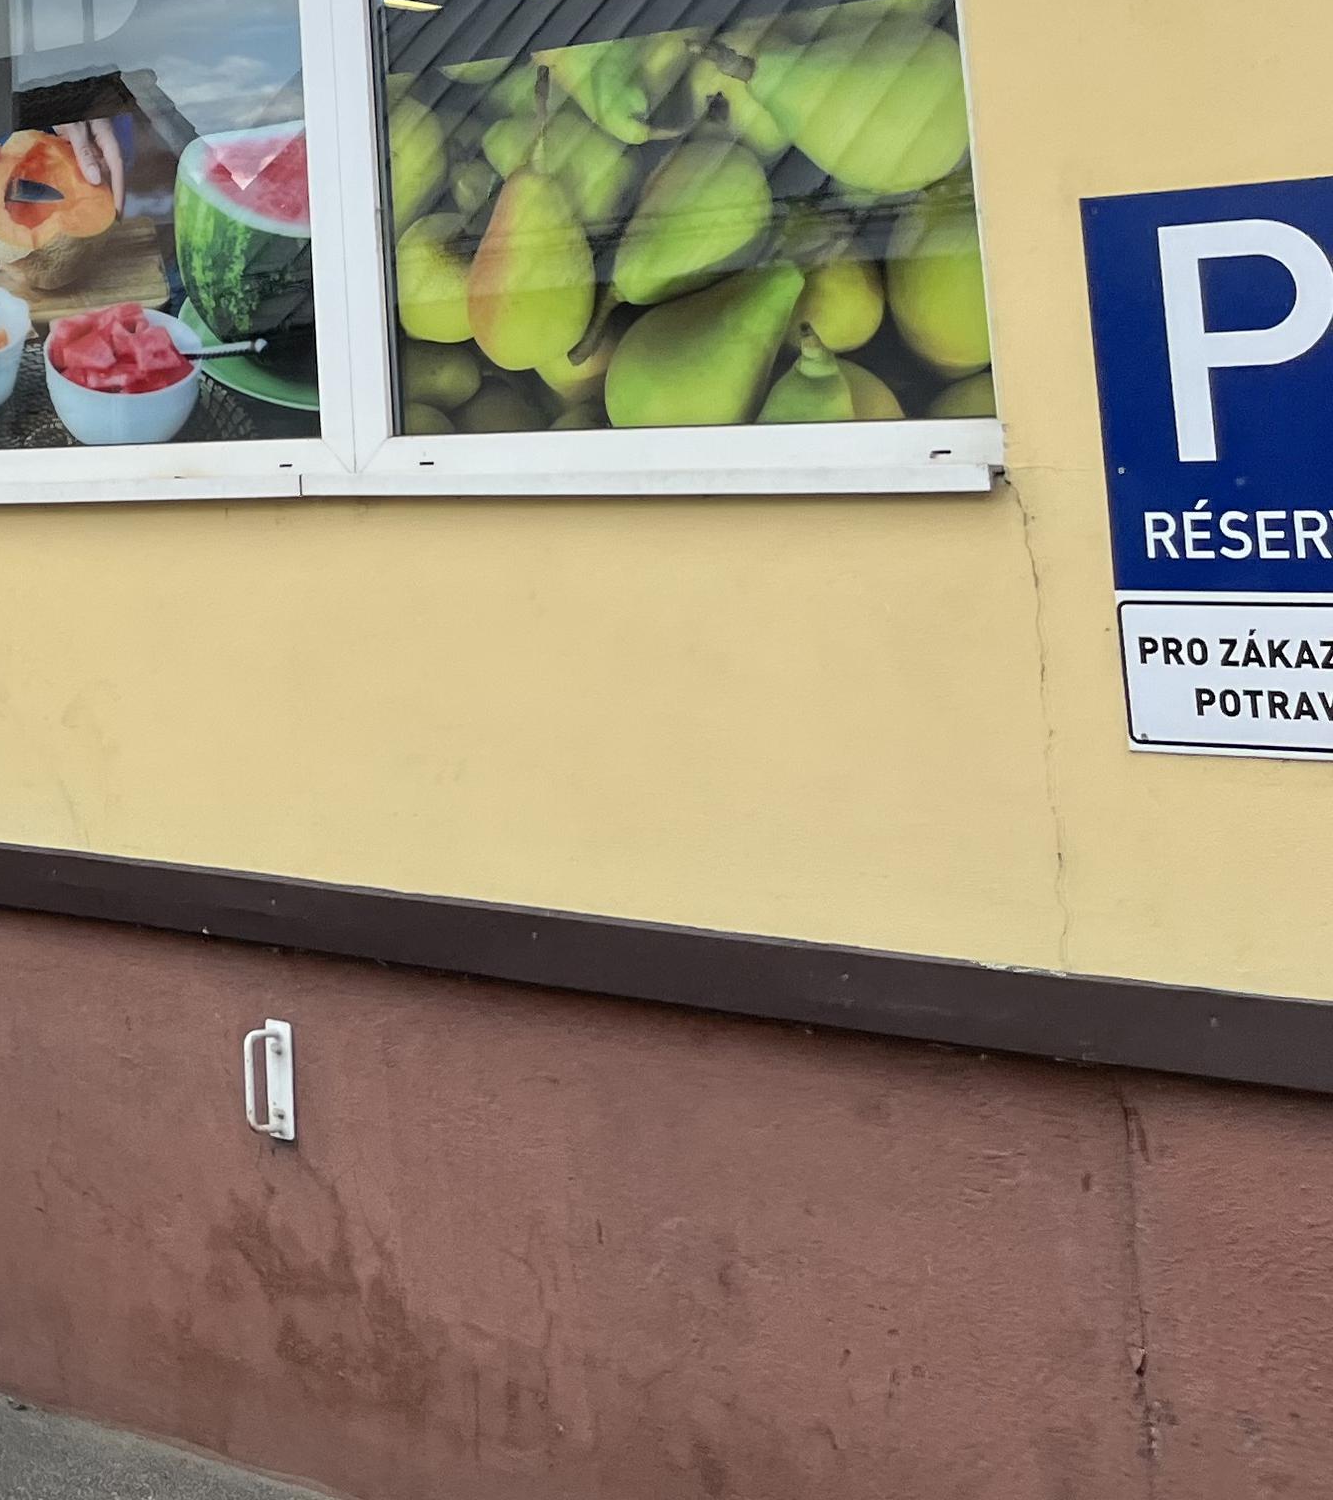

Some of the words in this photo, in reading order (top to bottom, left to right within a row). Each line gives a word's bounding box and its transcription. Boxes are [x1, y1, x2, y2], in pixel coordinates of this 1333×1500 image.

[1156, 218, 1333, 462] P
[1144, 499, 1333, 560] RÉSER
[1138, 636, 1208, 666] PRO
